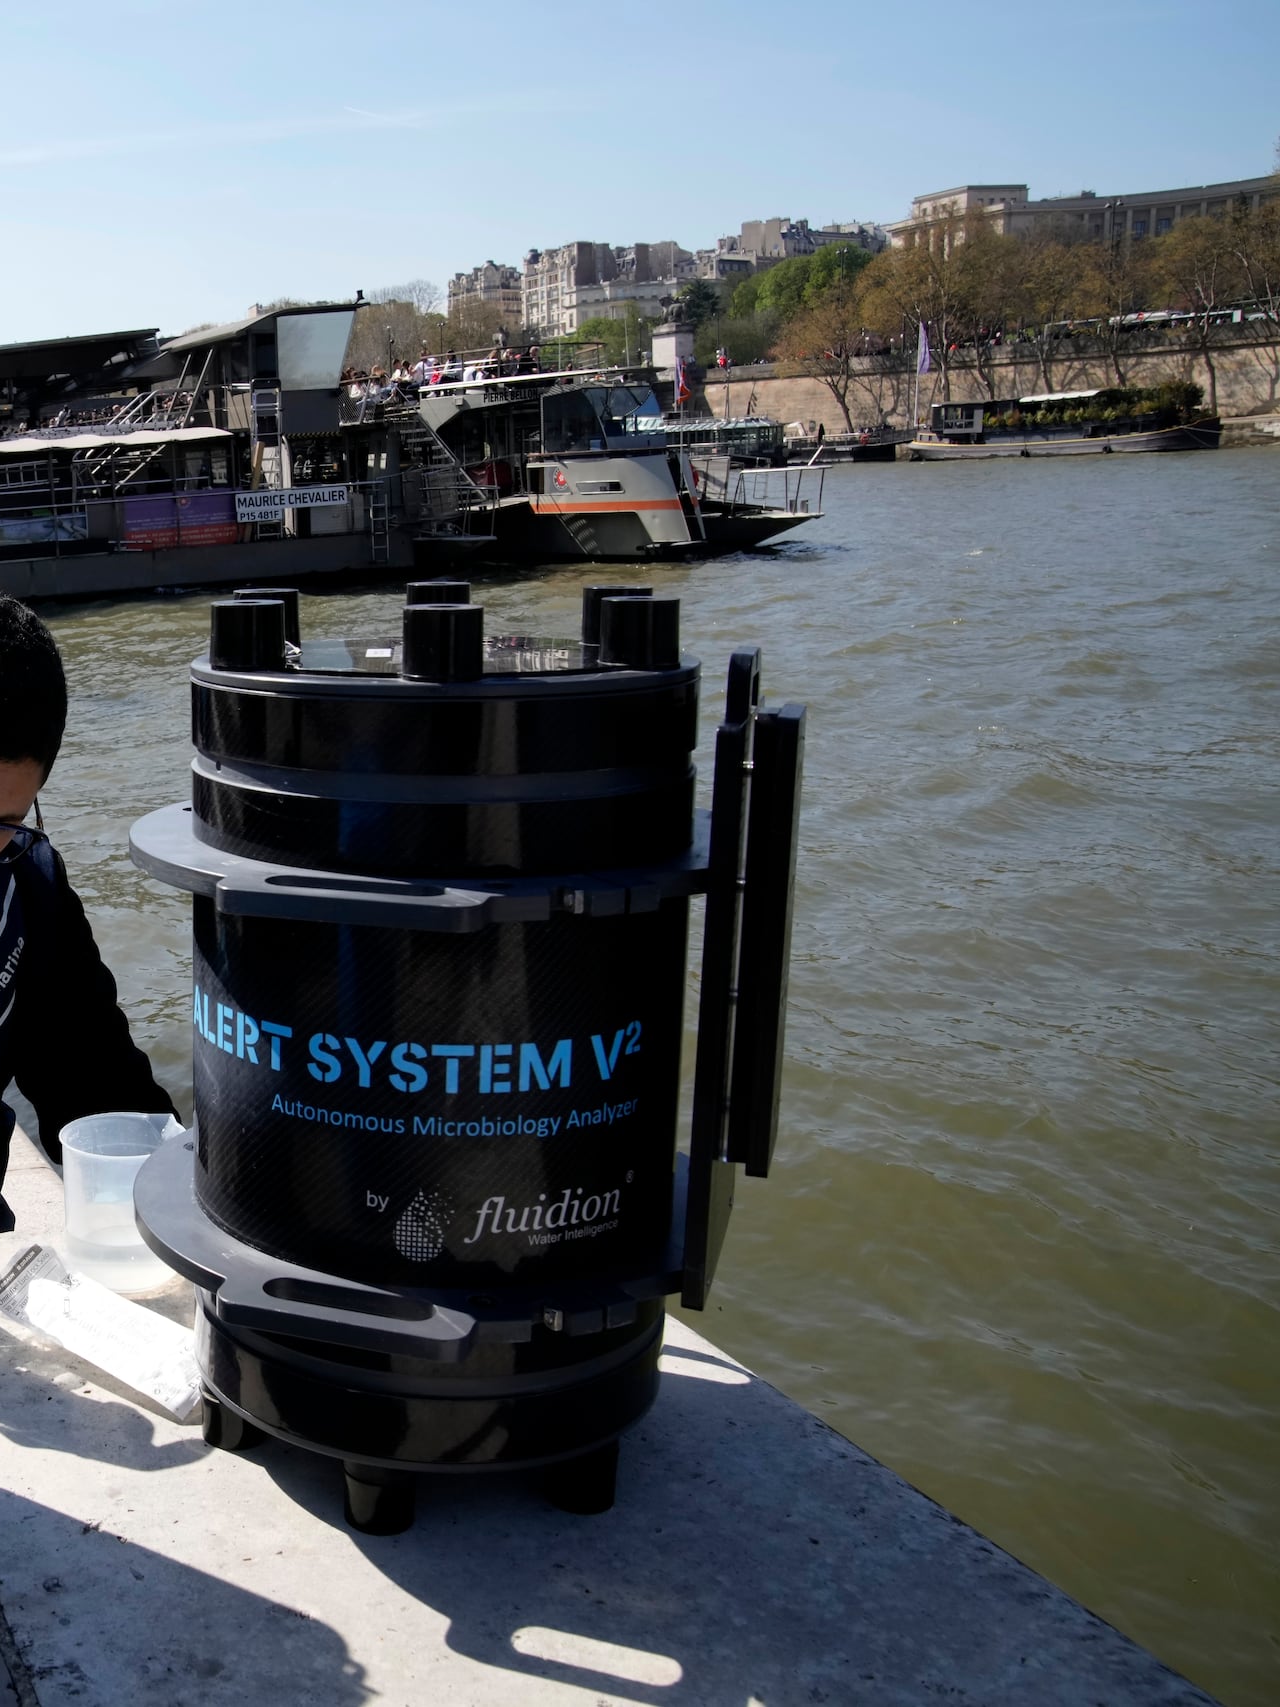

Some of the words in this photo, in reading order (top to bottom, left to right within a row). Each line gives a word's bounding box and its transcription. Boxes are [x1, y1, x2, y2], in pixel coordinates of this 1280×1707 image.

[483, 391, 509, 403] PIERRE
[510, 388, 539, 400] BELLON
[237, 494, 286, 508] MAURICE
[288, 490, 345, 505] CHEVALIER
[239, 511, 256, 521] P15
[257, 510, 280, 520] 481F
[193, 984, 292, 1071] ALERT
[307, 1032, 571, 1095] SYSTEM
[270, 1093, 405, 1135] Autonomous
[412, 1114, 562, 1139] Microbiology
[566, 1095, 638, 1128] Analyzer
[366, 1190, 389, 1213] by
[465, 1187, 621, 1243] fluidion
[527, 1231, 562, 1247] Water
[564, 1218, 619, 1242] Intelligence
